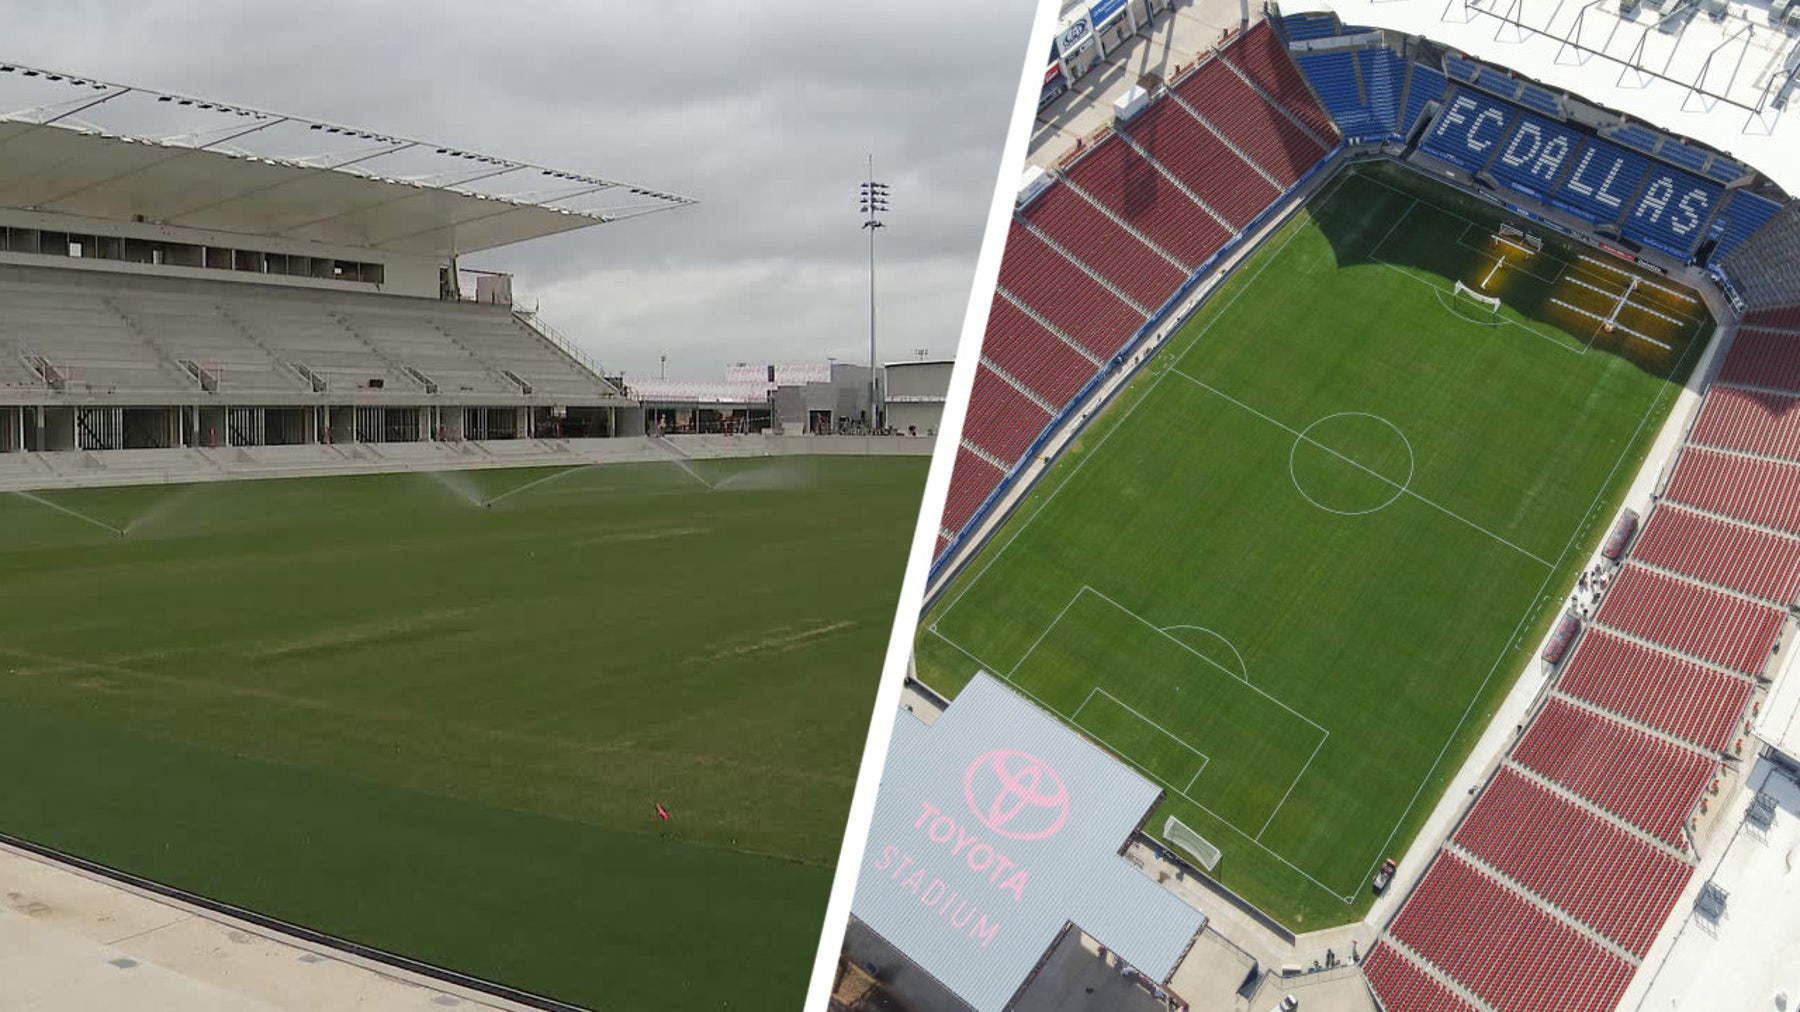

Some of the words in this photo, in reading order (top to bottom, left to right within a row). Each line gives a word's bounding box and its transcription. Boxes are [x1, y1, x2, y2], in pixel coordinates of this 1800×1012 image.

[1437, 95, 1504, 151] FC
[1502, 122, 1708, 234] DALLAS
[875, 844, 1000, 947] STADIUM
[914, 801, 1028, 901] TOYOTA
